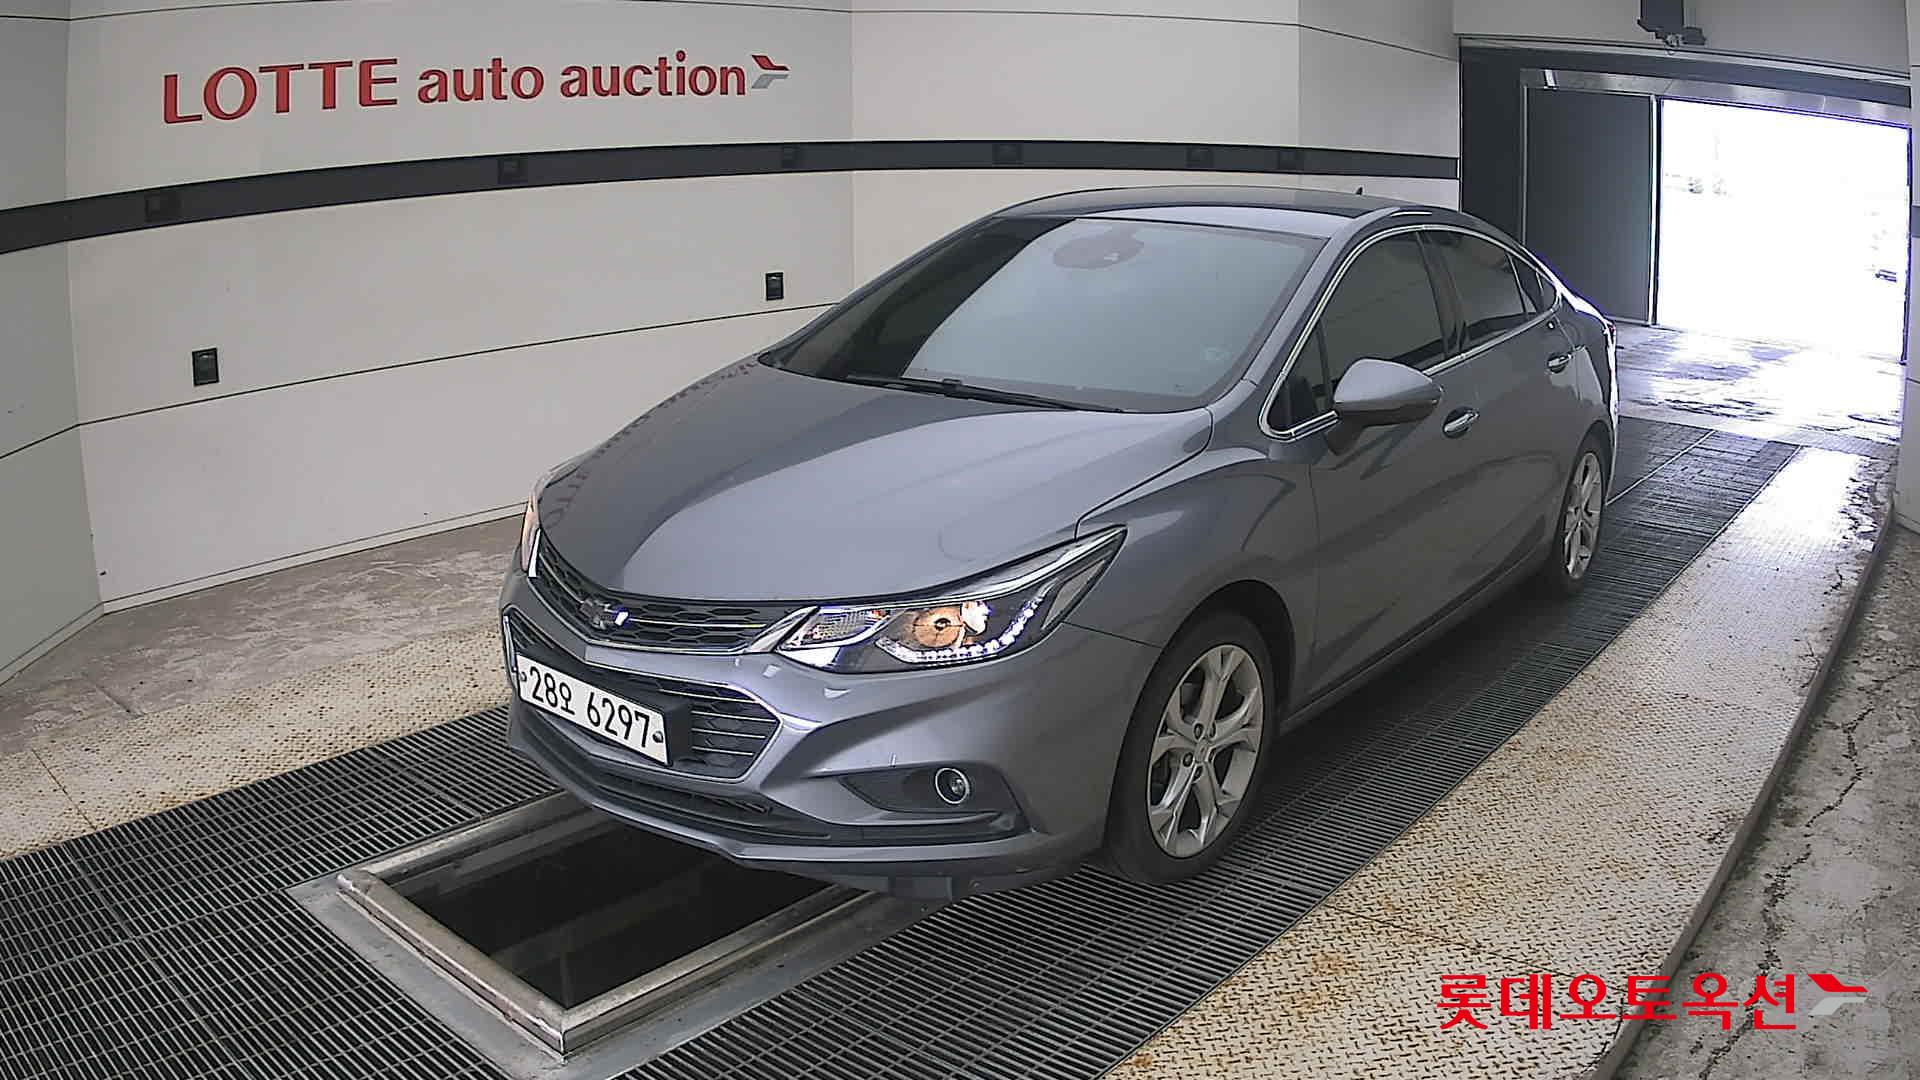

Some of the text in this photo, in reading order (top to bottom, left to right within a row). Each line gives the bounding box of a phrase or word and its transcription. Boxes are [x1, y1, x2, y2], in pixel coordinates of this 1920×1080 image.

[163, 51, 746, 124] LOTTE auto auction
[529, 666, 650, 748] 28오 6297
